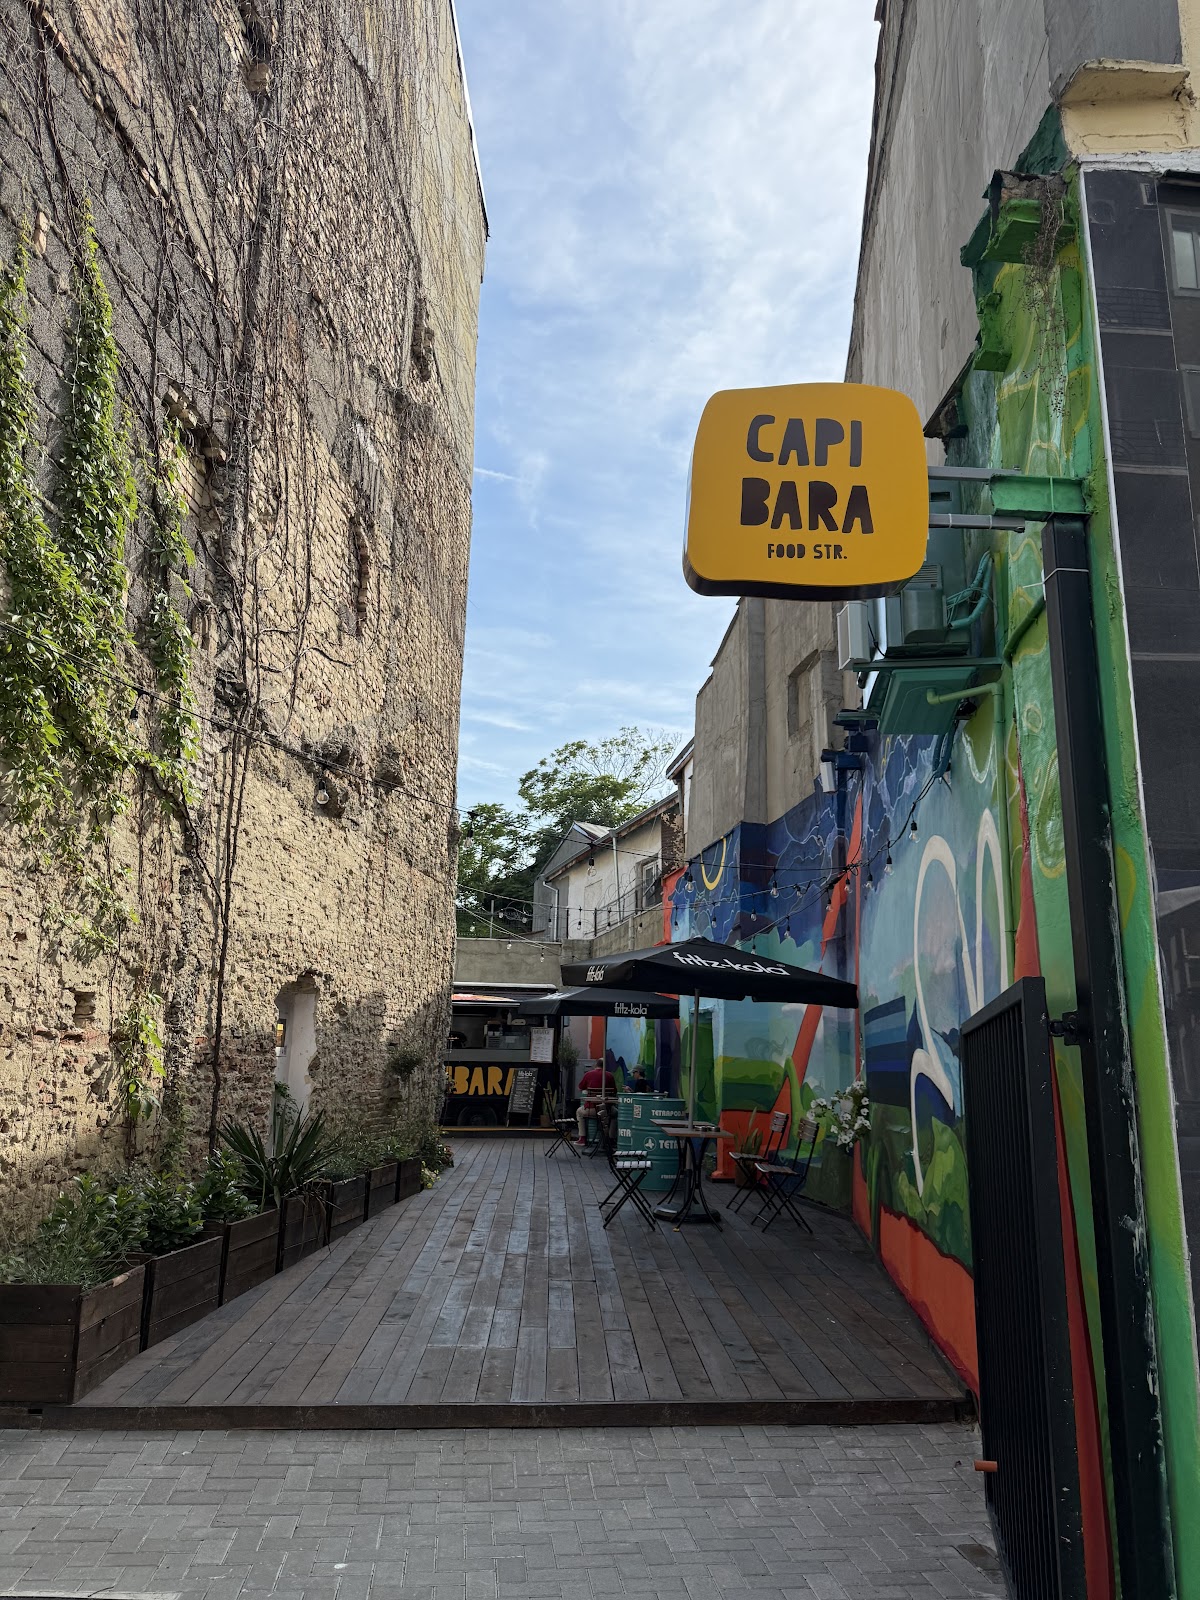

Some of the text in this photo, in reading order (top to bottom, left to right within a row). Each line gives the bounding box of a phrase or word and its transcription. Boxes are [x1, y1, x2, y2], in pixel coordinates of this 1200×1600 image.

[746, 414, 862, 467] CAPI
[740, 477, 874, 534] BARA
[767, 543, 848, 560] FOOD STR.
[672, 951, 791, 977] fritz-kola
[613, 1001, 648, 1015] fritz-kola
